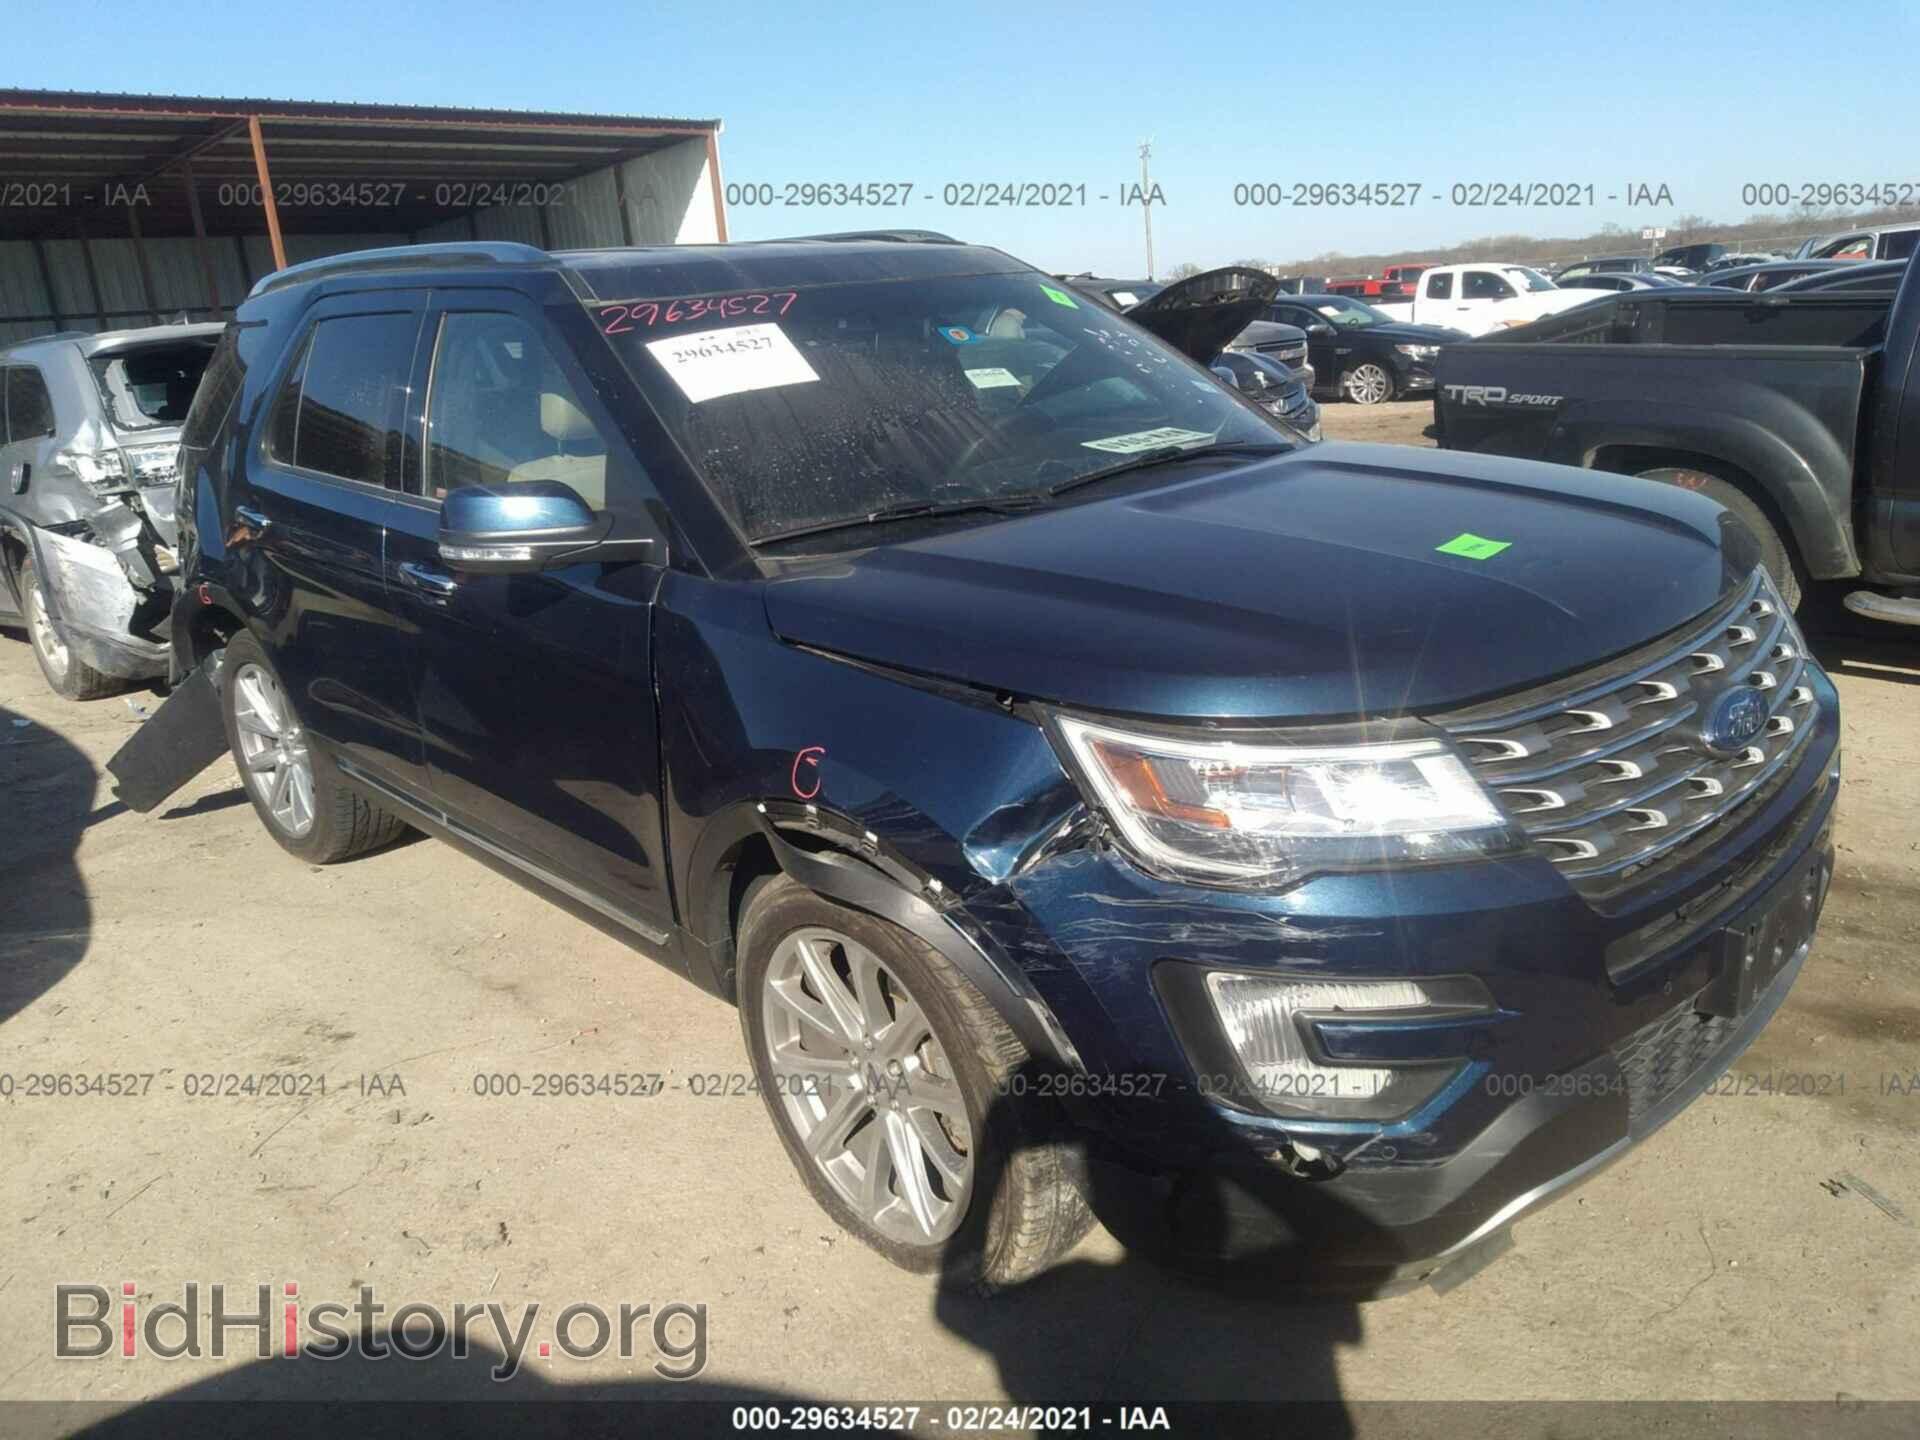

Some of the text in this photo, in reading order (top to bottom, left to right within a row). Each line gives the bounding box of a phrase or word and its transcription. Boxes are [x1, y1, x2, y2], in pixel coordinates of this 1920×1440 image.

[601, 292, 797, 334] 29634527
[1444, 384, 1564, 406] TRD SPORT
